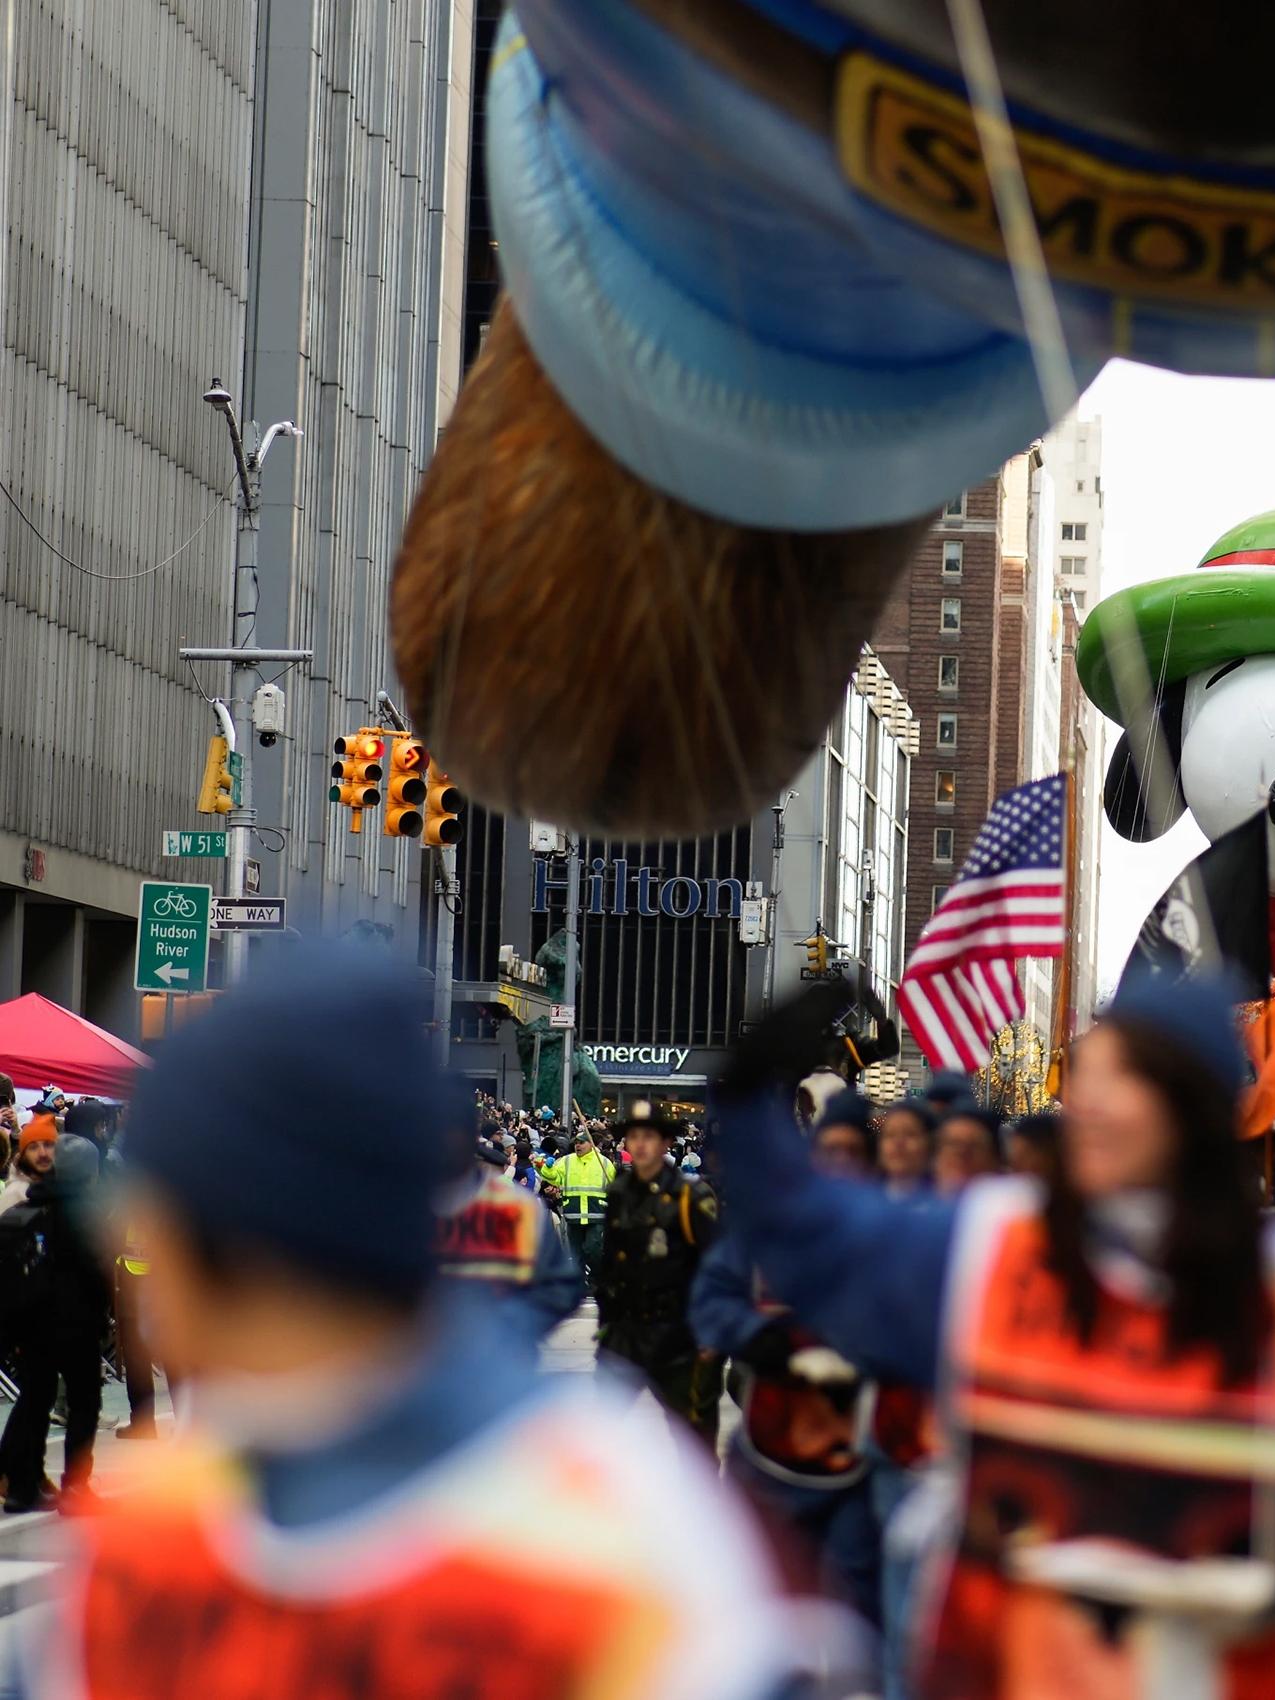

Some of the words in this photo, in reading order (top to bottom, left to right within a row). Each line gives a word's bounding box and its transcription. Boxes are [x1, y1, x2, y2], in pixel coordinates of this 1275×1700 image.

[181, 835, 192, 852] W
[197, 835, 212, 854] 51
[215, 835, 225, 847] St
[531, 858, 743, 918] Hilton
[246, 908, 275, 920] WAY
[150, 923, 197, 940] Hudson
[156, 942, 189, 957] River
